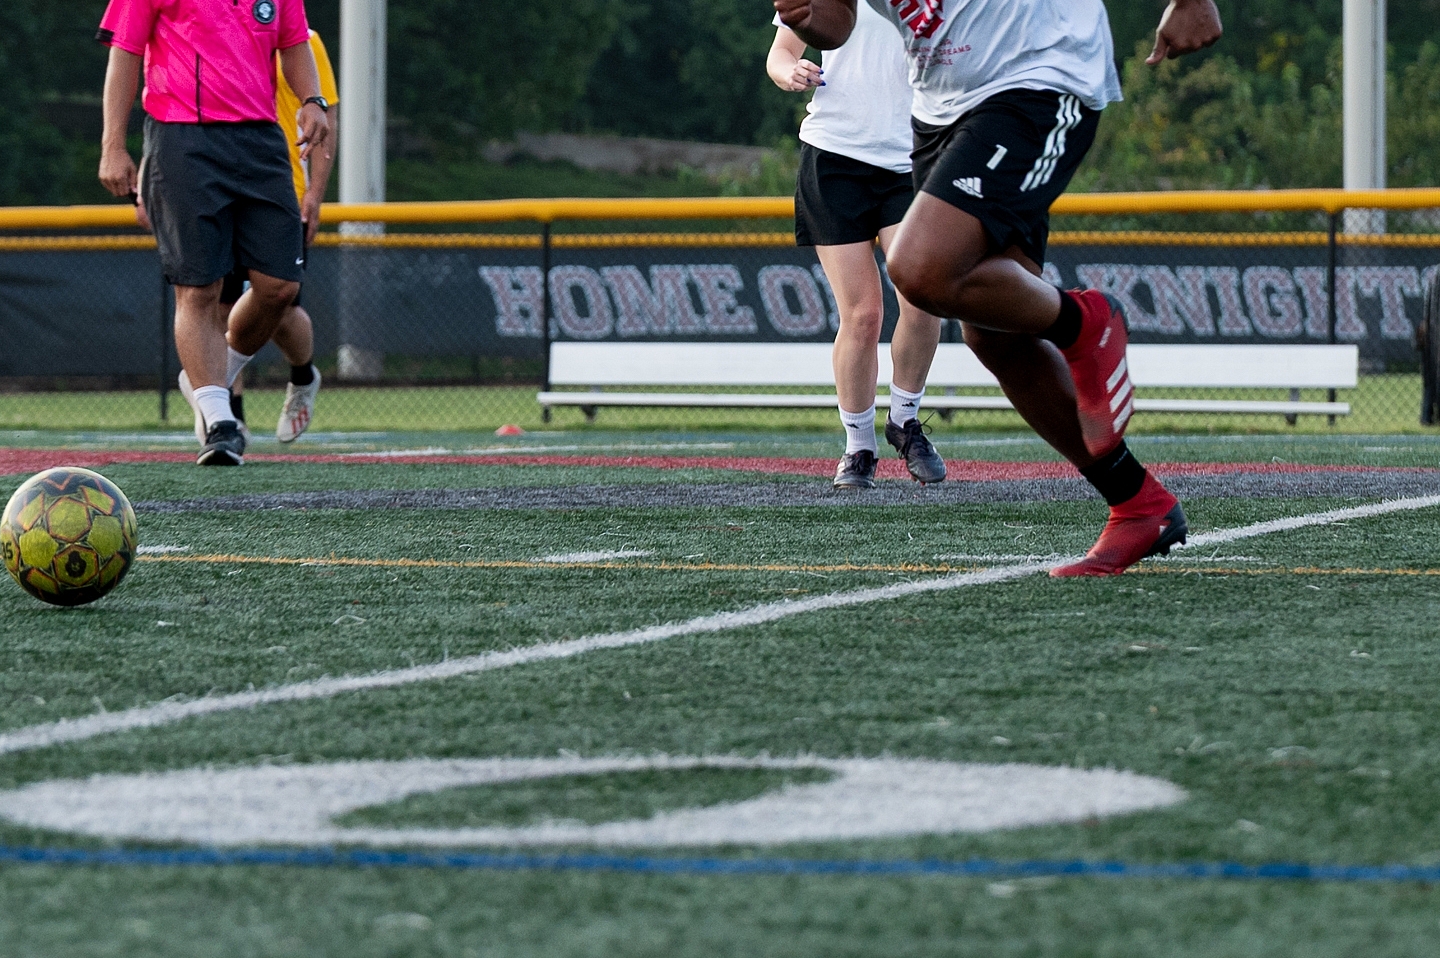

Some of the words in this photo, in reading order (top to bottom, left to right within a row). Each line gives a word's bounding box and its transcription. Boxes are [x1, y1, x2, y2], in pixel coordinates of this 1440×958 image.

[986, 143, 1009, 171] 1
[477, 263, 759, 340] HOME
[1075, 262, 1436, 341] KNIGHT
